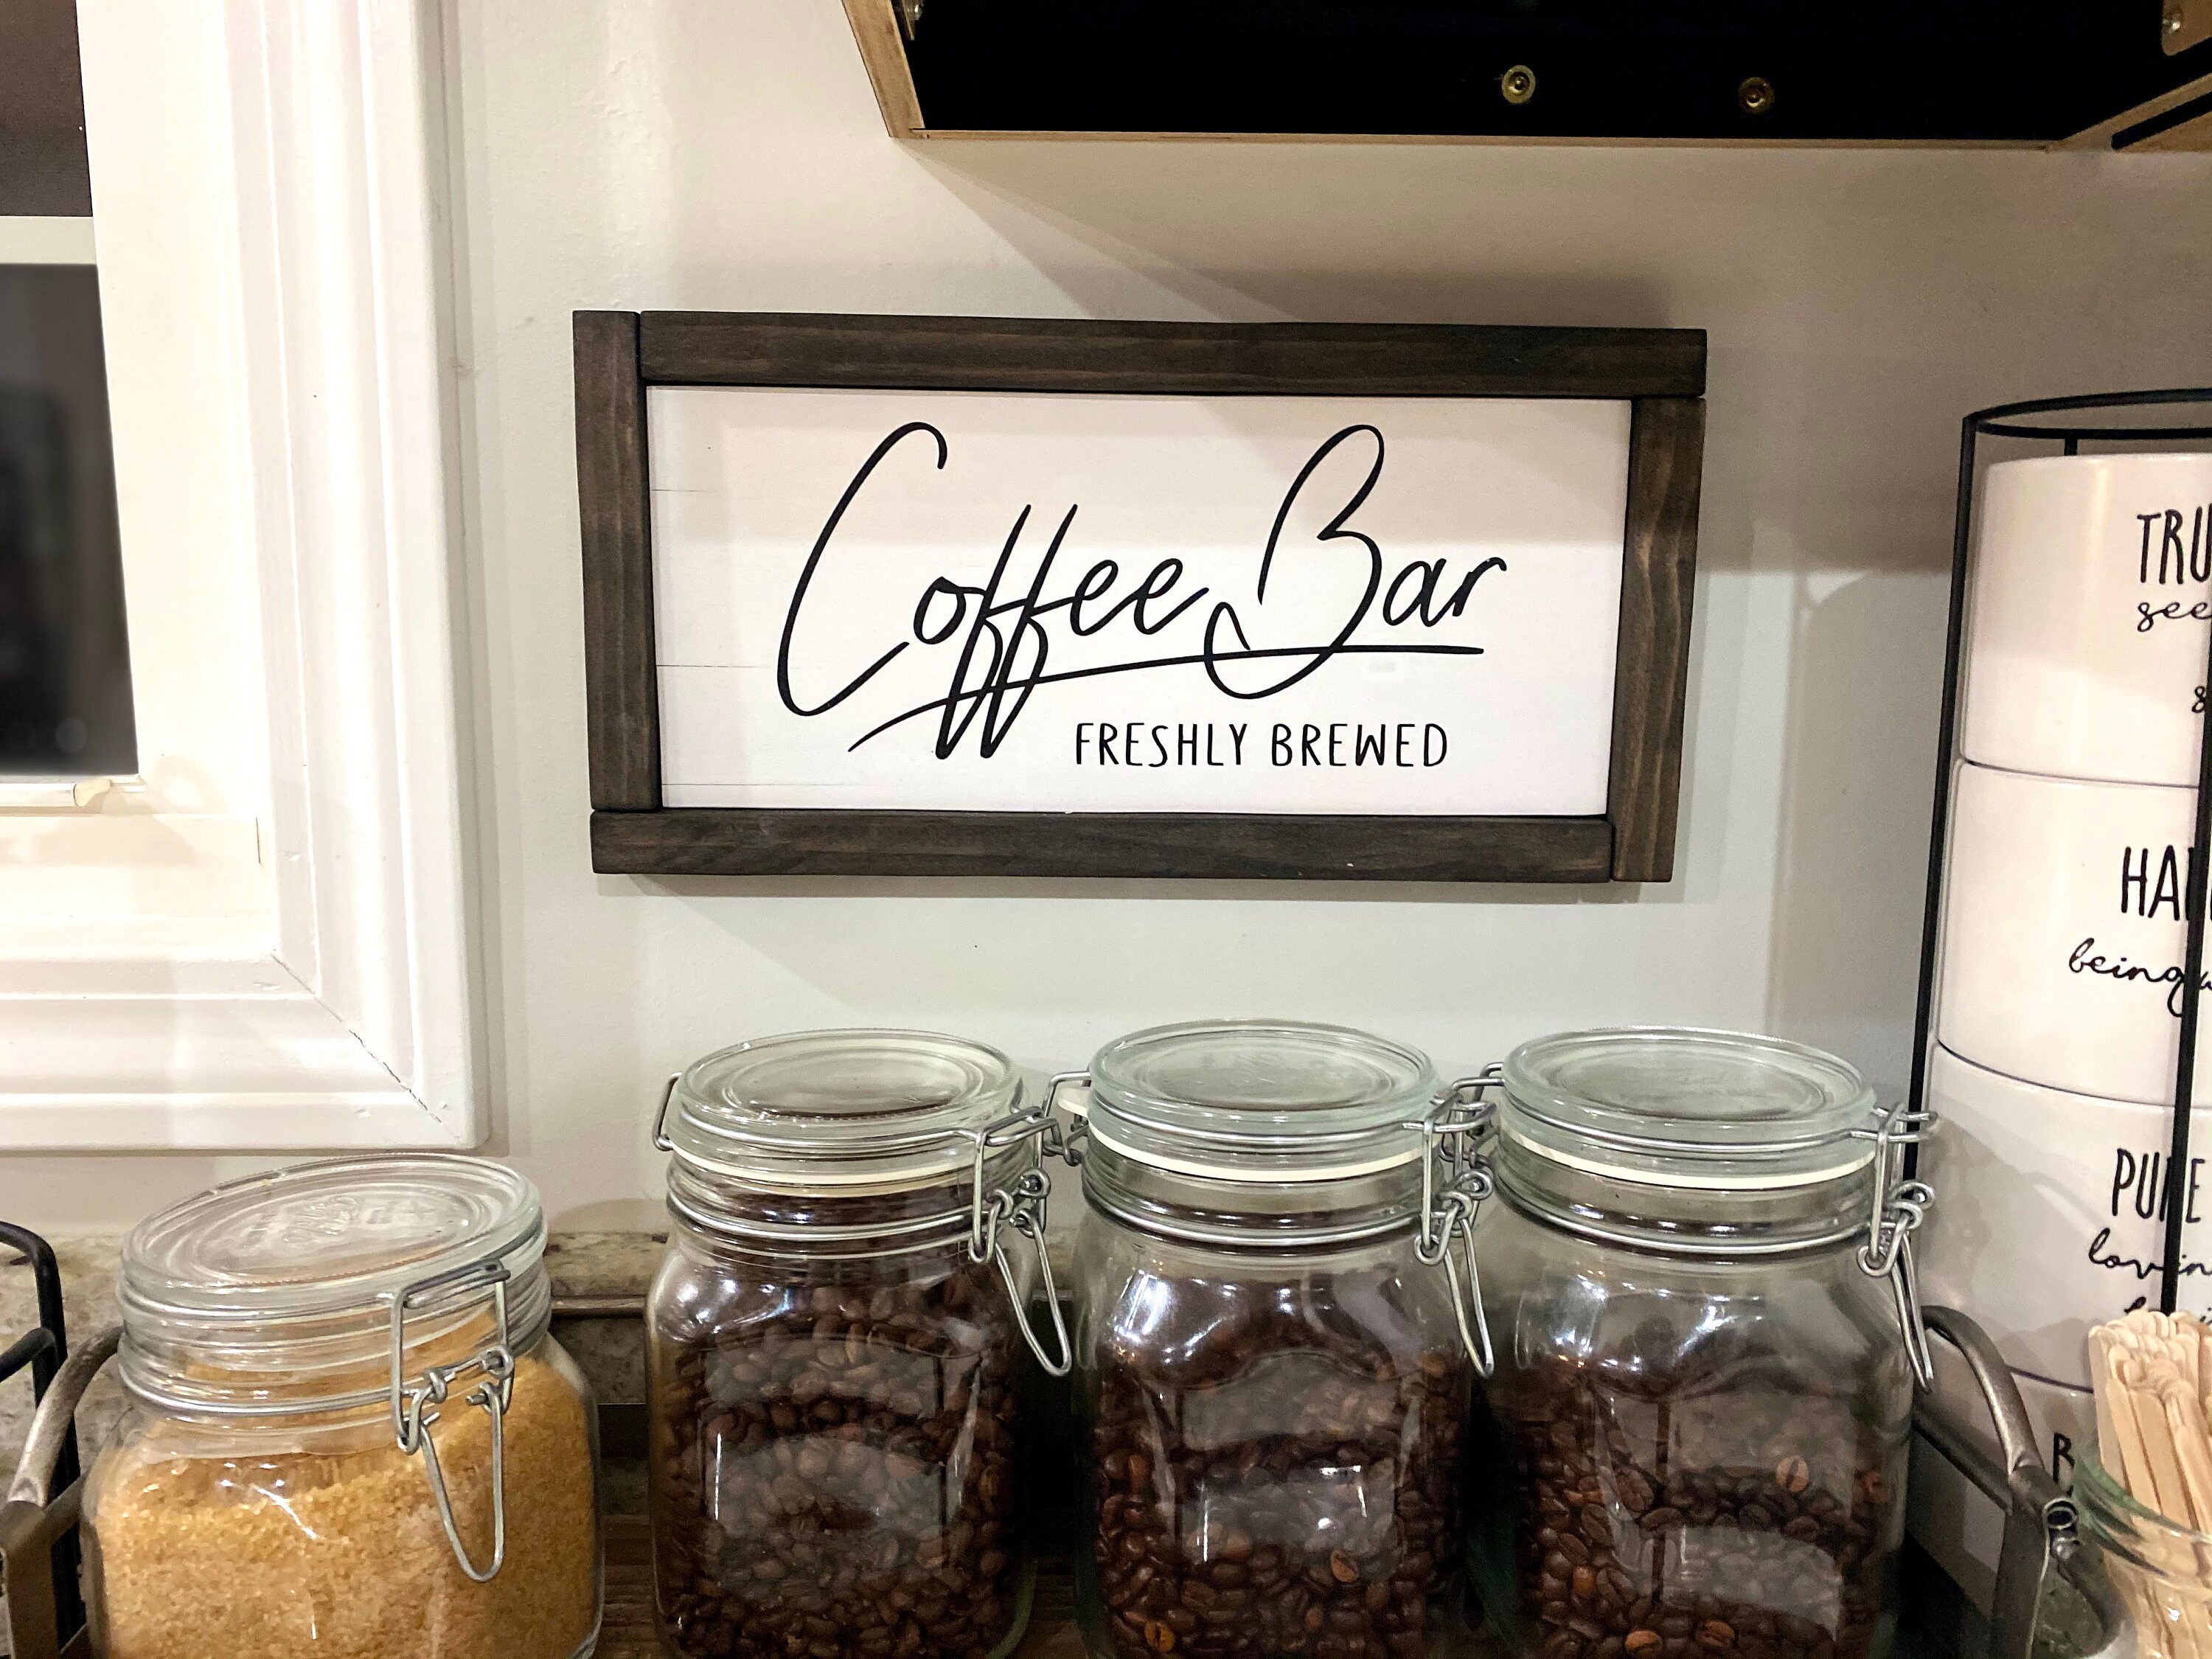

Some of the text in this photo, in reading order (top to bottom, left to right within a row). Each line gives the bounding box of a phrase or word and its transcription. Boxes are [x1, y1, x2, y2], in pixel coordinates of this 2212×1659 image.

[776, 421, 1507, 760] Coffee Bar
[1075, 722, 1448, 768] FRESHLY BREWED
[2121, 844, 2212, 922] HA
